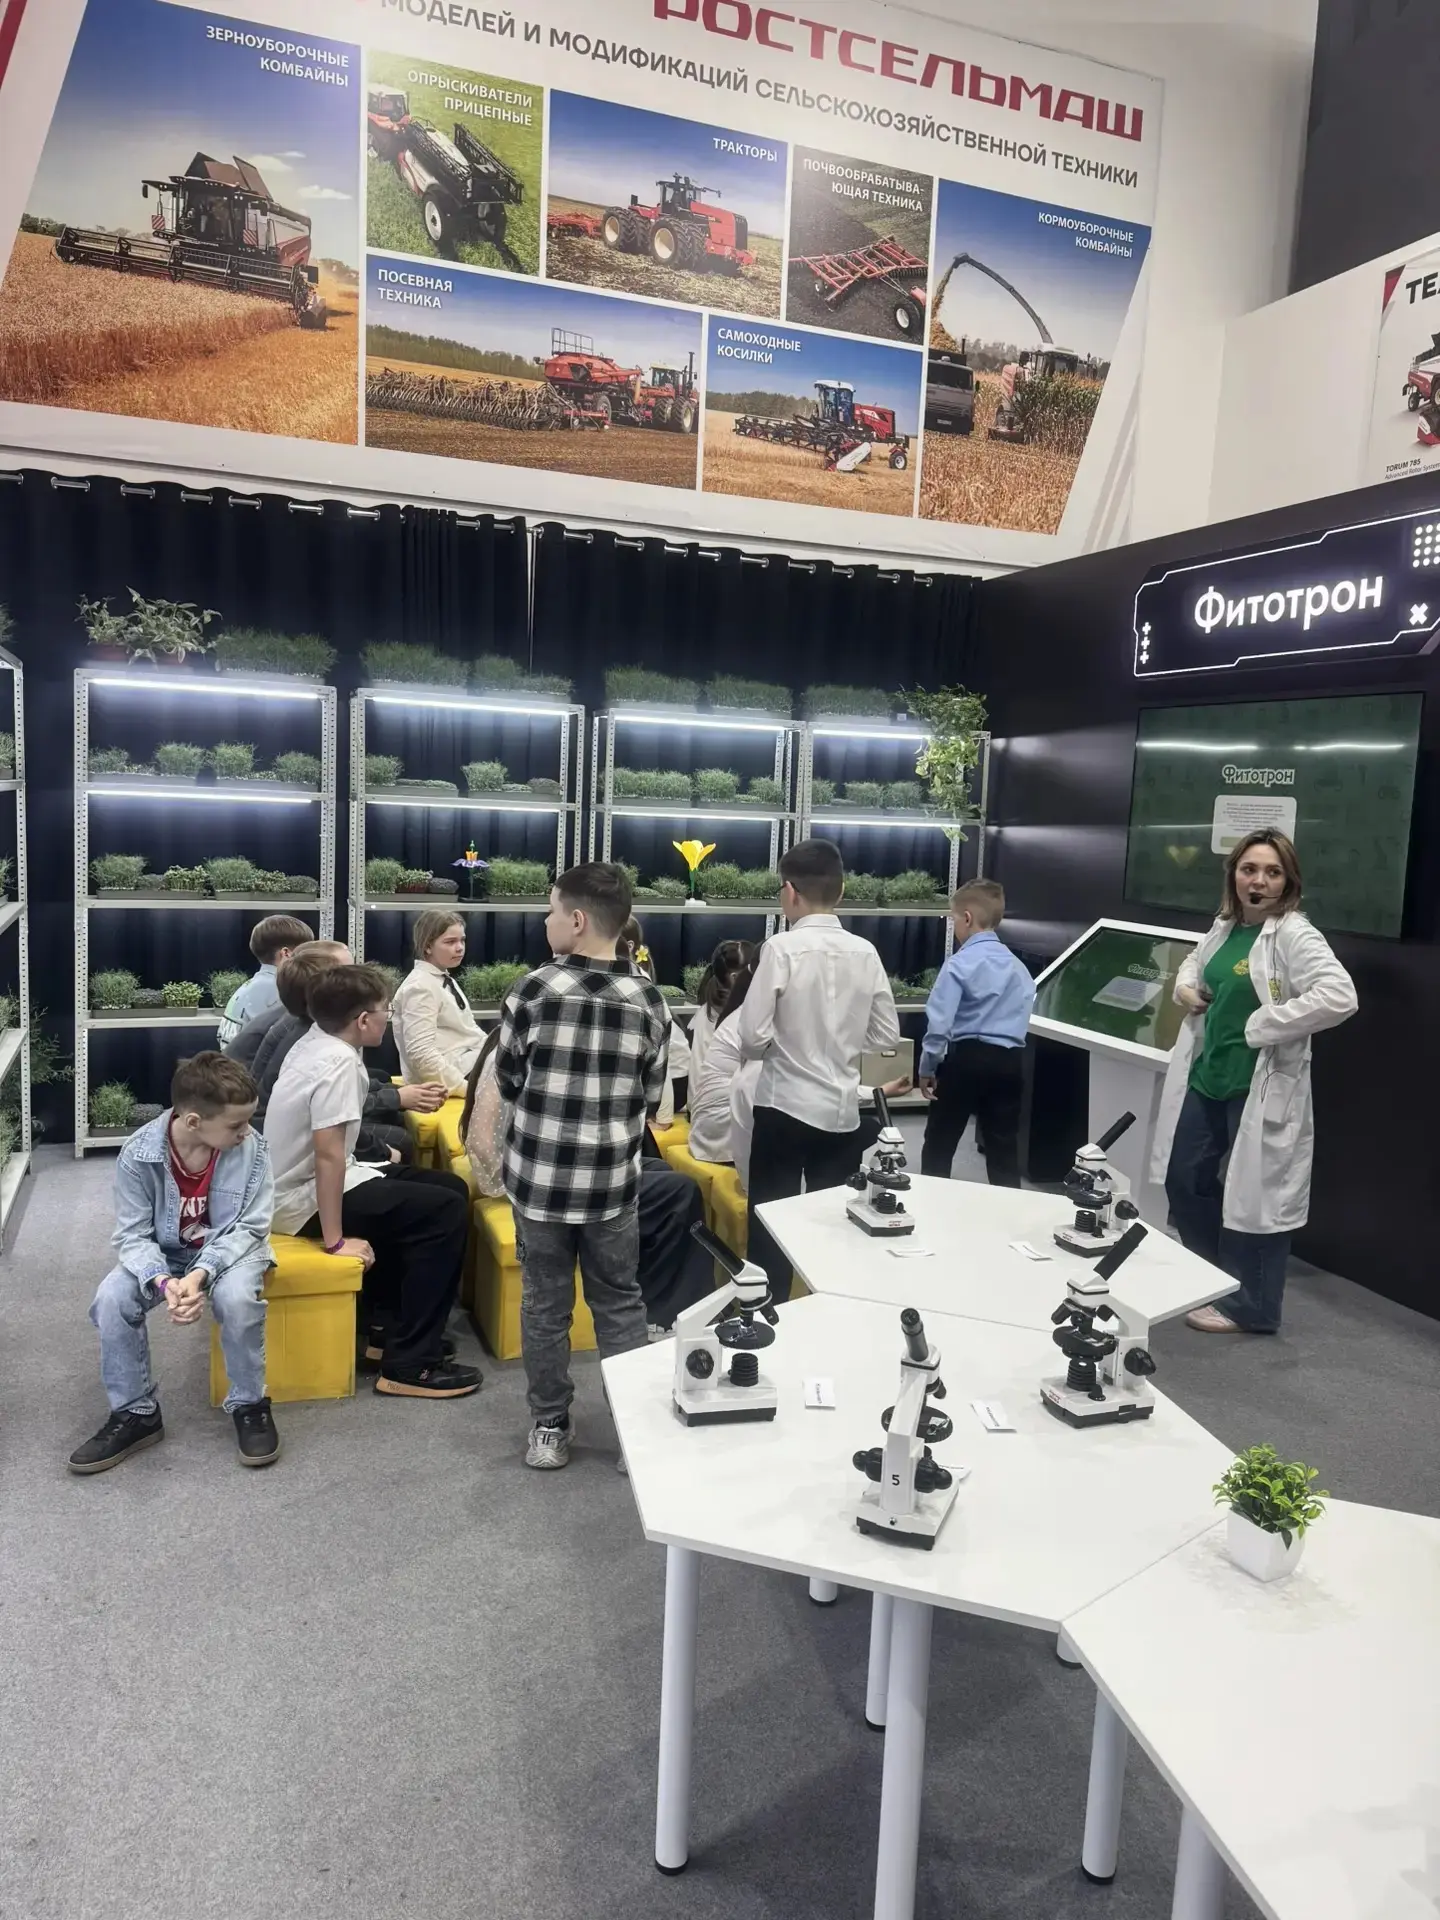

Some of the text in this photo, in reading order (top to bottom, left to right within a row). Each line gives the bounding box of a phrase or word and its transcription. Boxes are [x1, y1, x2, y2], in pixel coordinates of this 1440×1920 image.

[206, 25, 350, 68] ЗЕРНОУБОРОЧНЫЕ
[260, 57, 349, 87] КОМБАЙНЫ
[408, 70, 533, 108] ОПРЫСКИВАТЕЛИ
[444, 97, 532, 126] ПРИЦЕПНЫЕ
[524, 22, 541, 44] И
[550, 28, 748, 94] МОДИФИКАЦИЙ
[755, 78, 1047, 167] СЕЛЬСКОХОЗЯЙСТВЕННОЙ
[1051, 151, 1139, 188] ТЕХНИКИ
[713, 138, 778, 162] ТРАКТОРЫ
[803, 158, 924, 195] ПОЧВООБРАБАТЫВА-
[832, 182, 923, 212] ЮЩАЯ ТЕХНИКА
[1038, 212, 1134, 243] КОРМОУБОРОЧНЫЕ
[1075, 236, 1133, 258] КОМБАЙНЫ
[378, 268, 453, 292] ПОСЕВНАЯ
[1406, 271, 1440, 305] ТЕ
[378, 287, 442, 309] ТЕХНИКА
[717, 327, 802, 352] САМОХОДНЫЕ
[717, 345, 773, 364] КОСИЛКИ
[1386, 458, 1421, 472] TORUM 785
[1194, 576, 1383, 634] Фитотрон
[1222, 764, 1295, 788] Фитотрон
[892, 1474, 900, 1486] 5
